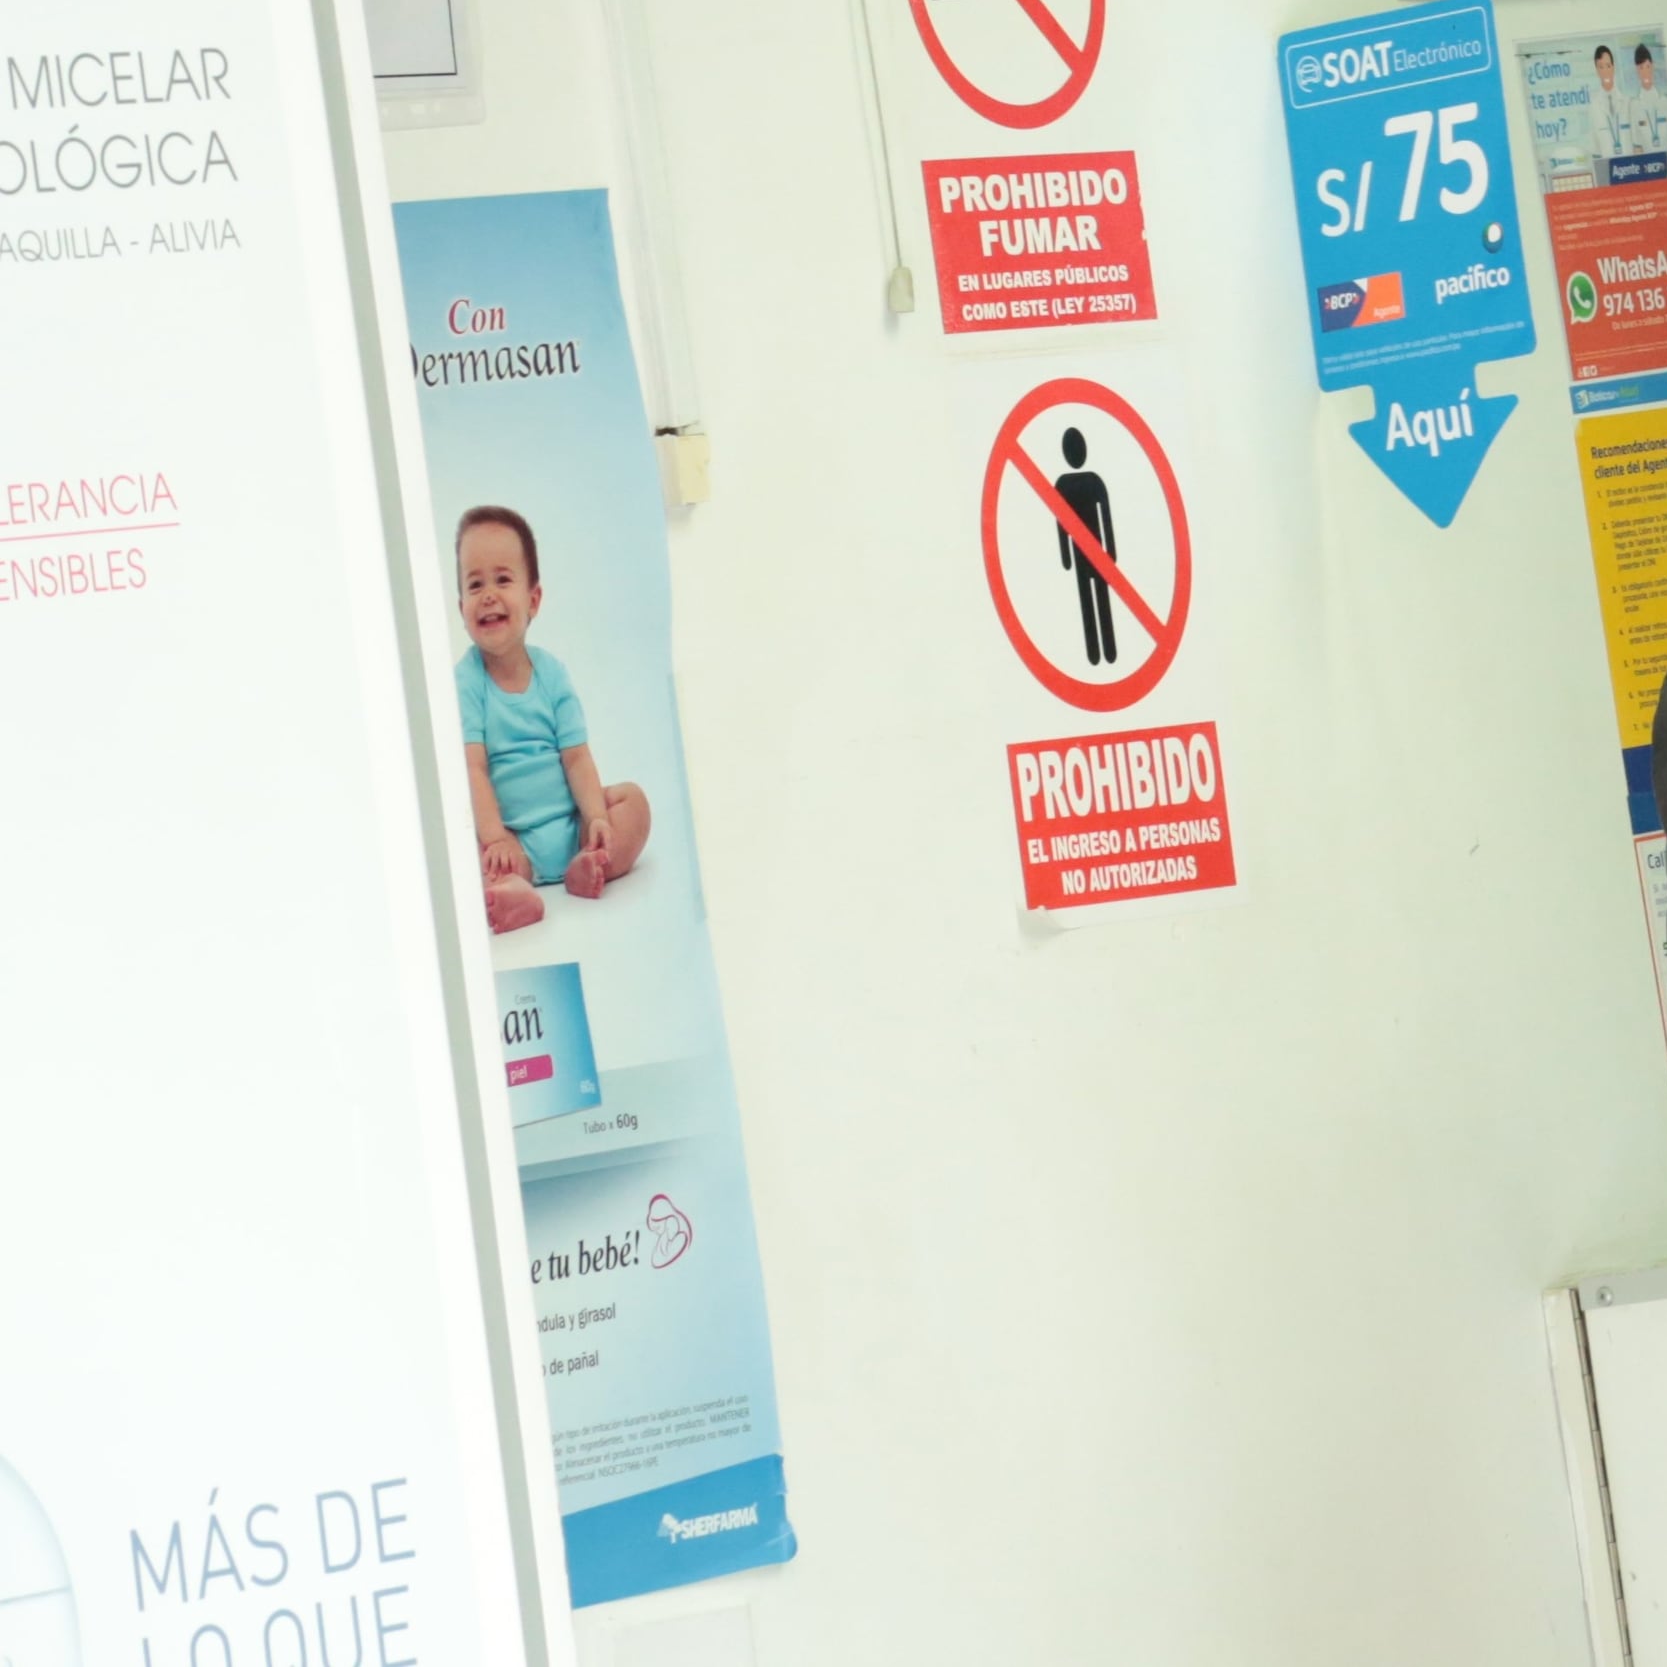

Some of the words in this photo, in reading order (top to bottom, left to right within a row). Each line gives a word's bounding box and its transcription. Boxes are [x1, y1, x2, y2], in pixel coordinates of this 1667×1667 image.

[8, 48, 231, 109] MICELAR
[1323, 41, 1392, 88] SOAT
[1393, 37, 1482, 71] Electrónico
[939, 168, 1128, 213] PROHIBIDO
[1316, 161, 1373, 238] S/
[1384, 101, 1490, 222] 75
[150, 218, 241, 254] ALIVIA
[979, 215, 1102, 257] FUMAR
[958, 273, 981, 292] EN
[984, 268, 1052, 290] LUGARES
[1054, 263, 1129, 285] PÚBLICOS
[449, 299, 505, 334] Con
[962, 302, 1006, 322] COMO
[1011, 300, 1049, 318] ESTE
[1053, 296, 1084, 319] (LEY
[1088, 293, 1137, 316] 25357)
[1603, 292, 1634, 317] 974
[1637, 288, 1665, 312] 136
[1386, 389, 1473, 456] Aquí
[1595, 464, 1624, 479] cliente
[1627, 460, 1640, 474] del
[1016, 731, 1216, 822] PROHIBIDO
[1027, 839, 1049, 863] EL
[1051, 832, 1121, 861] INGRESO
[1125, 830, 1137, 853] A
[1139, 817, 1221, 851] PERSONAS
[1061, 871, 1086, 895] NO
[1090, 855, 1197, 892] AUTORIZADAS
[548, 1251, 570, 1280] tu
[578, 1230, 639, 1275] bebé!
[680, 1503, 758, 1539] SHERFARMA
[129, 1487, 290, 1611] MÁS
[315, 1477, 416, 1574] DE
